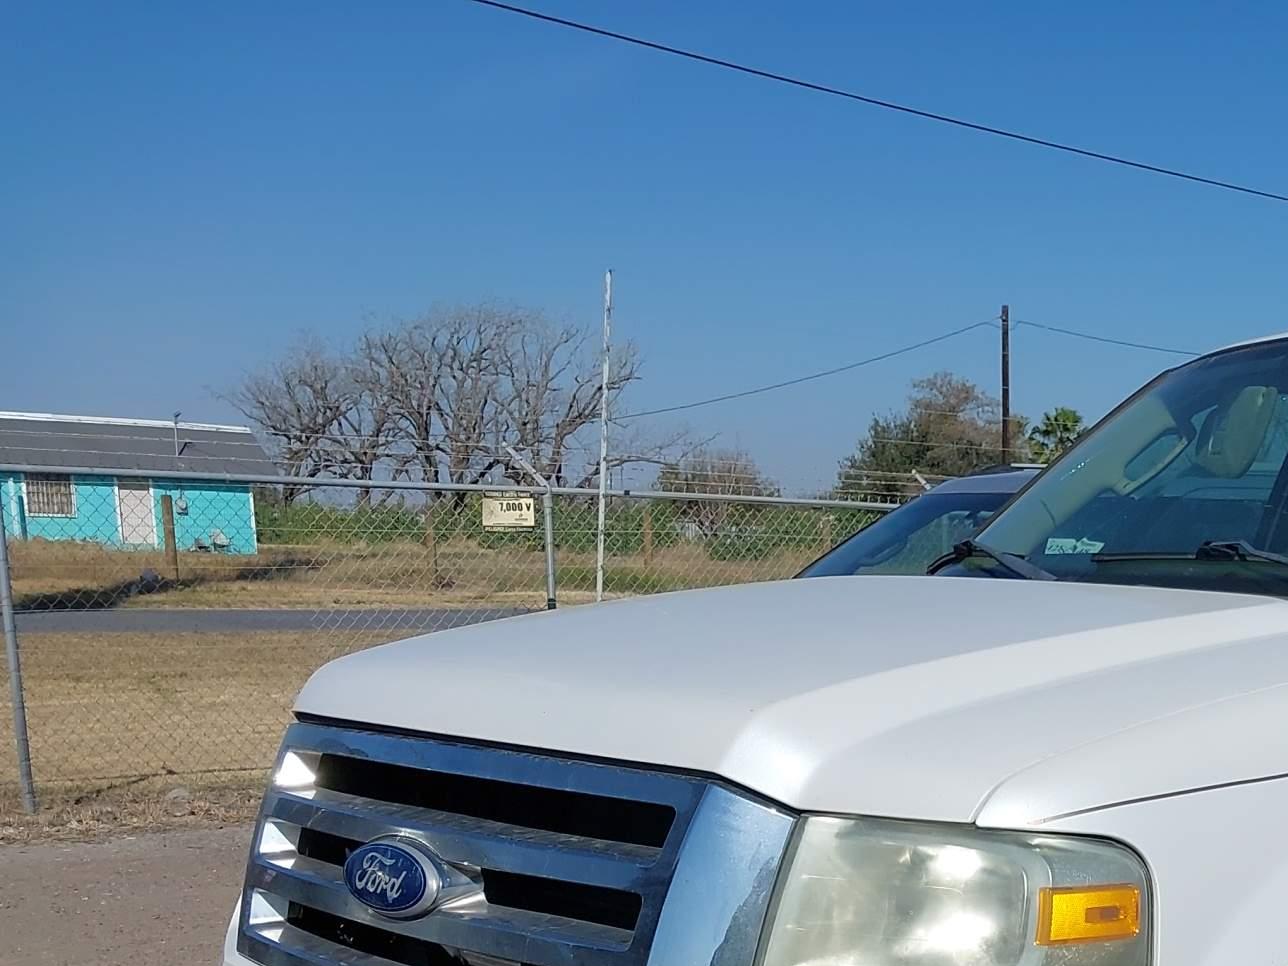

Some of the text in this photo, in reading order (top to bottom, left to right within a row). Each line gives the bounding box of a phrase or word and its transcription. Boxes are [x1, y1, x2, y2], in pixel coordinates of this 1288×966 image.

[499, 502, 531, 513] 7,000 V
[354, 851, 407, 904] Ford
